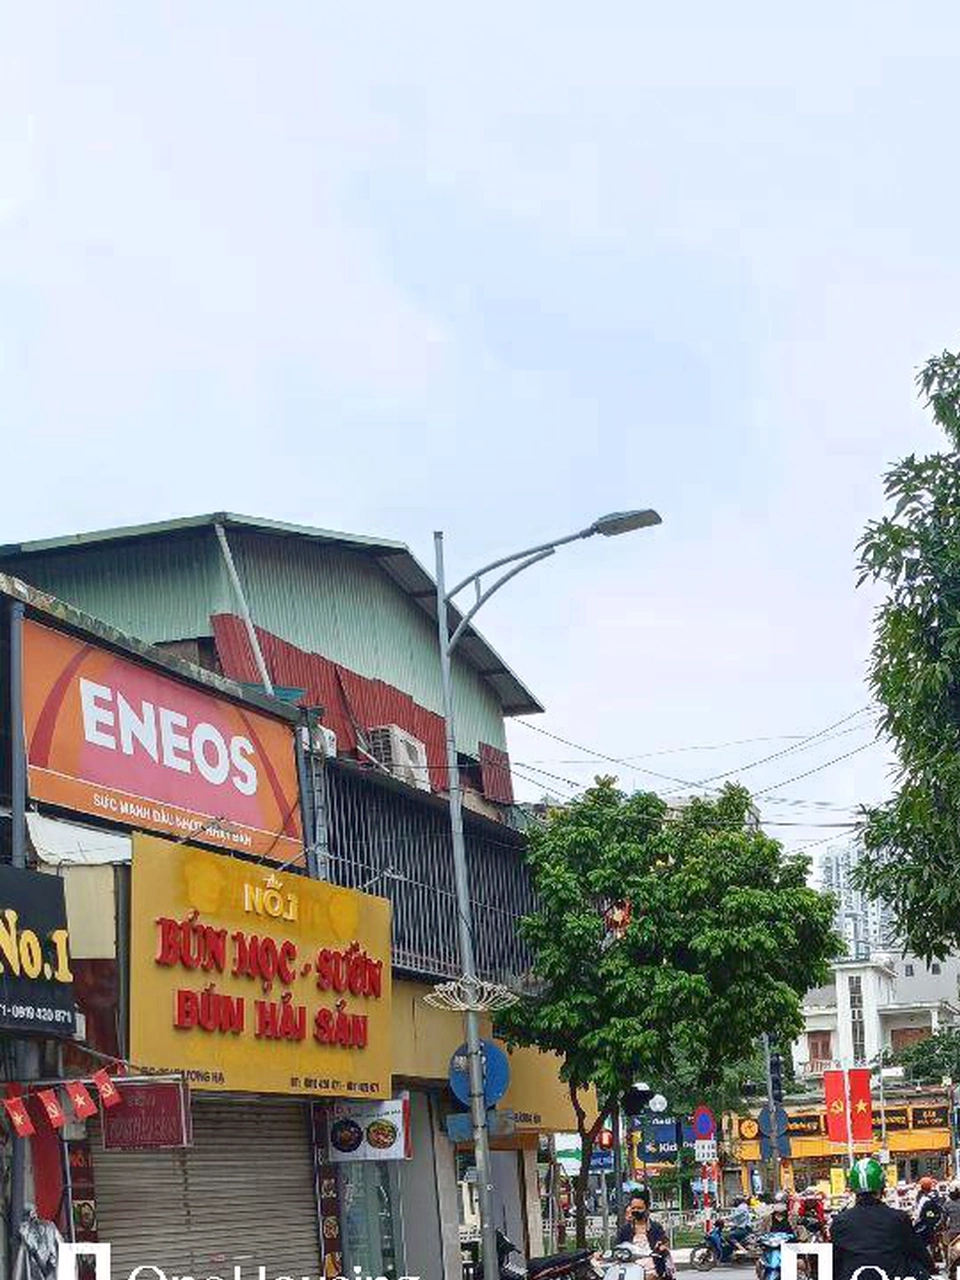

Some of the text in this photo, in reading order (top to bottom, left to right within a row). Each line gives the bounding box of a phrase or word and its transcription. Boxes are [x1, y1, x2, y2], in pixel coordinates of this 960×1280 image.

[80, 677, 257, 796] ENEOS
[231, 931, 299, 993] MỌC
[254, 991, 307, 1042] HẢI
[313, 998, 369, 1049] SẢN
